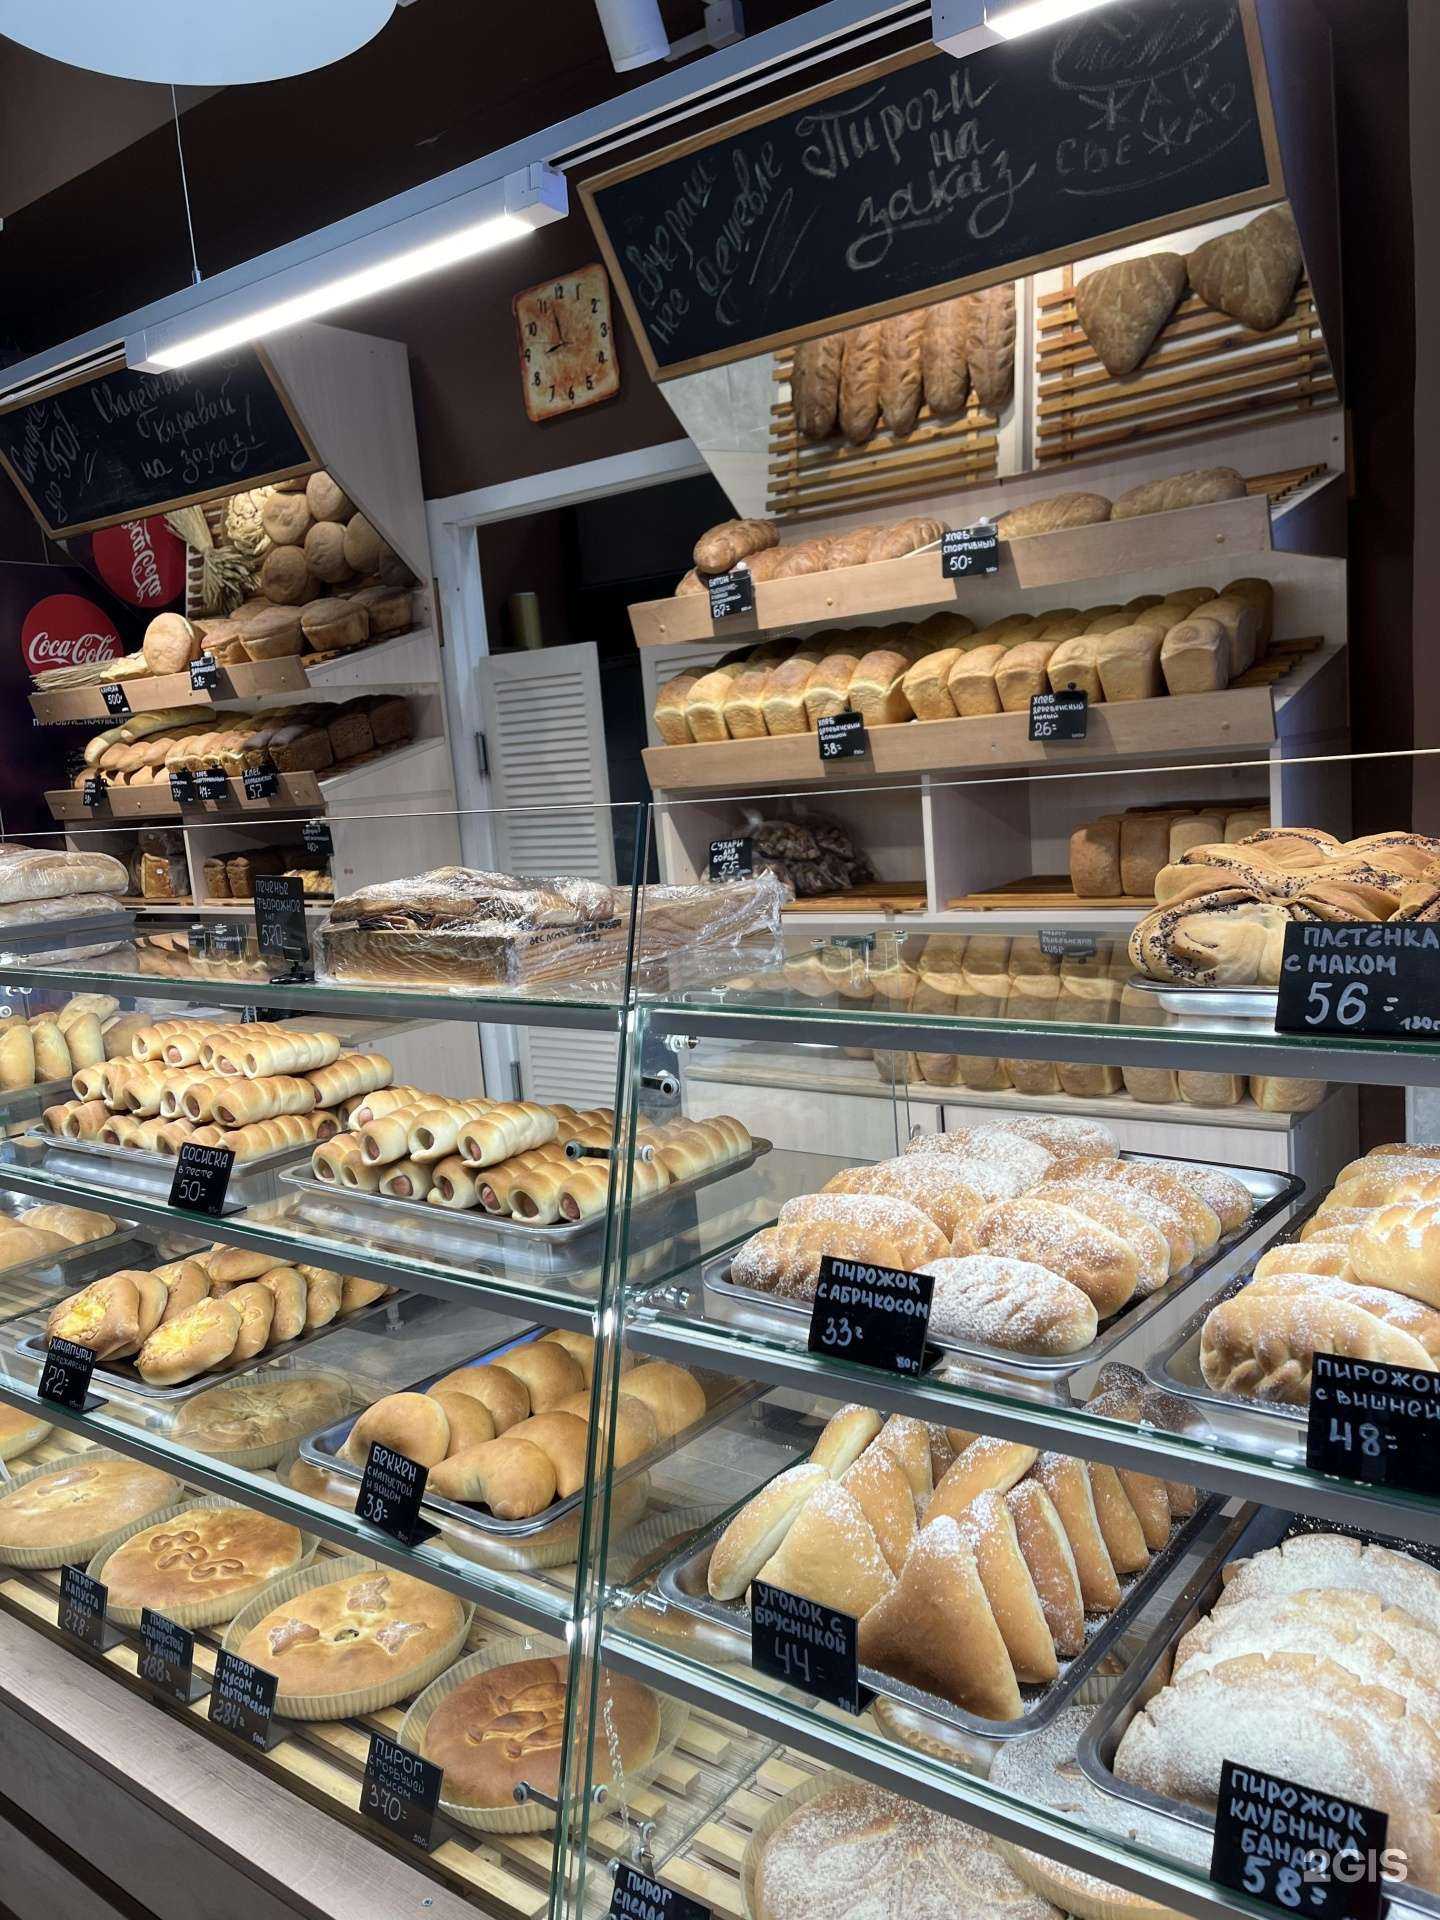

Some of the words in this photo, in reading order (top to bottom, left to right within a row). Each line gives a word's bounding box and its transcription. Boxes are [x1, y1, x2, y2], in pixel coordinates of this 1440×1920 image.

[795, 67, 999, 179] Пироги
[930, 118, 995, 167] на
[846, 151, 1036, 269] заказ
[554, 284, 563, 299] 12
[575, 283, 582, 300] 1
[537, 299, 547, 314] 11
[591, 298, 599, 313] 2
[525, 322, 537, 336] 10
[600, 322, 607, 337] 3
[598, 351, 607, 363] 4
[533, 371, 541, 386] 8
[586, 375, 594, 390] 5
[549, 385, 555, 402] 7
[568, 386, 574, 400] 6
[1307, 954, 1397, 976] МАКОМ
[181, 1145, 229, 1169] СОСИСКА
[831, 1261, 921, 1294] ПИРОЖОК
[829, 1284, 929, 1319] АБРИКОСОМ
[50, 1338, 93, 1363] ХАЧАПУРИ
[758, 1584, 824, 1627] УГОЛОК
[754, 1605, 847, 1655] БРУСНИКОЙ
[225, 1655, 256, 1678] ПИРОГ
[1230, 1769, 1368, 1837] ПИРОЖОК
[1229, 1797, 1360, 1862] КЛУБНИКА
[626, 1871, 673, 1905] ПИРОГ
